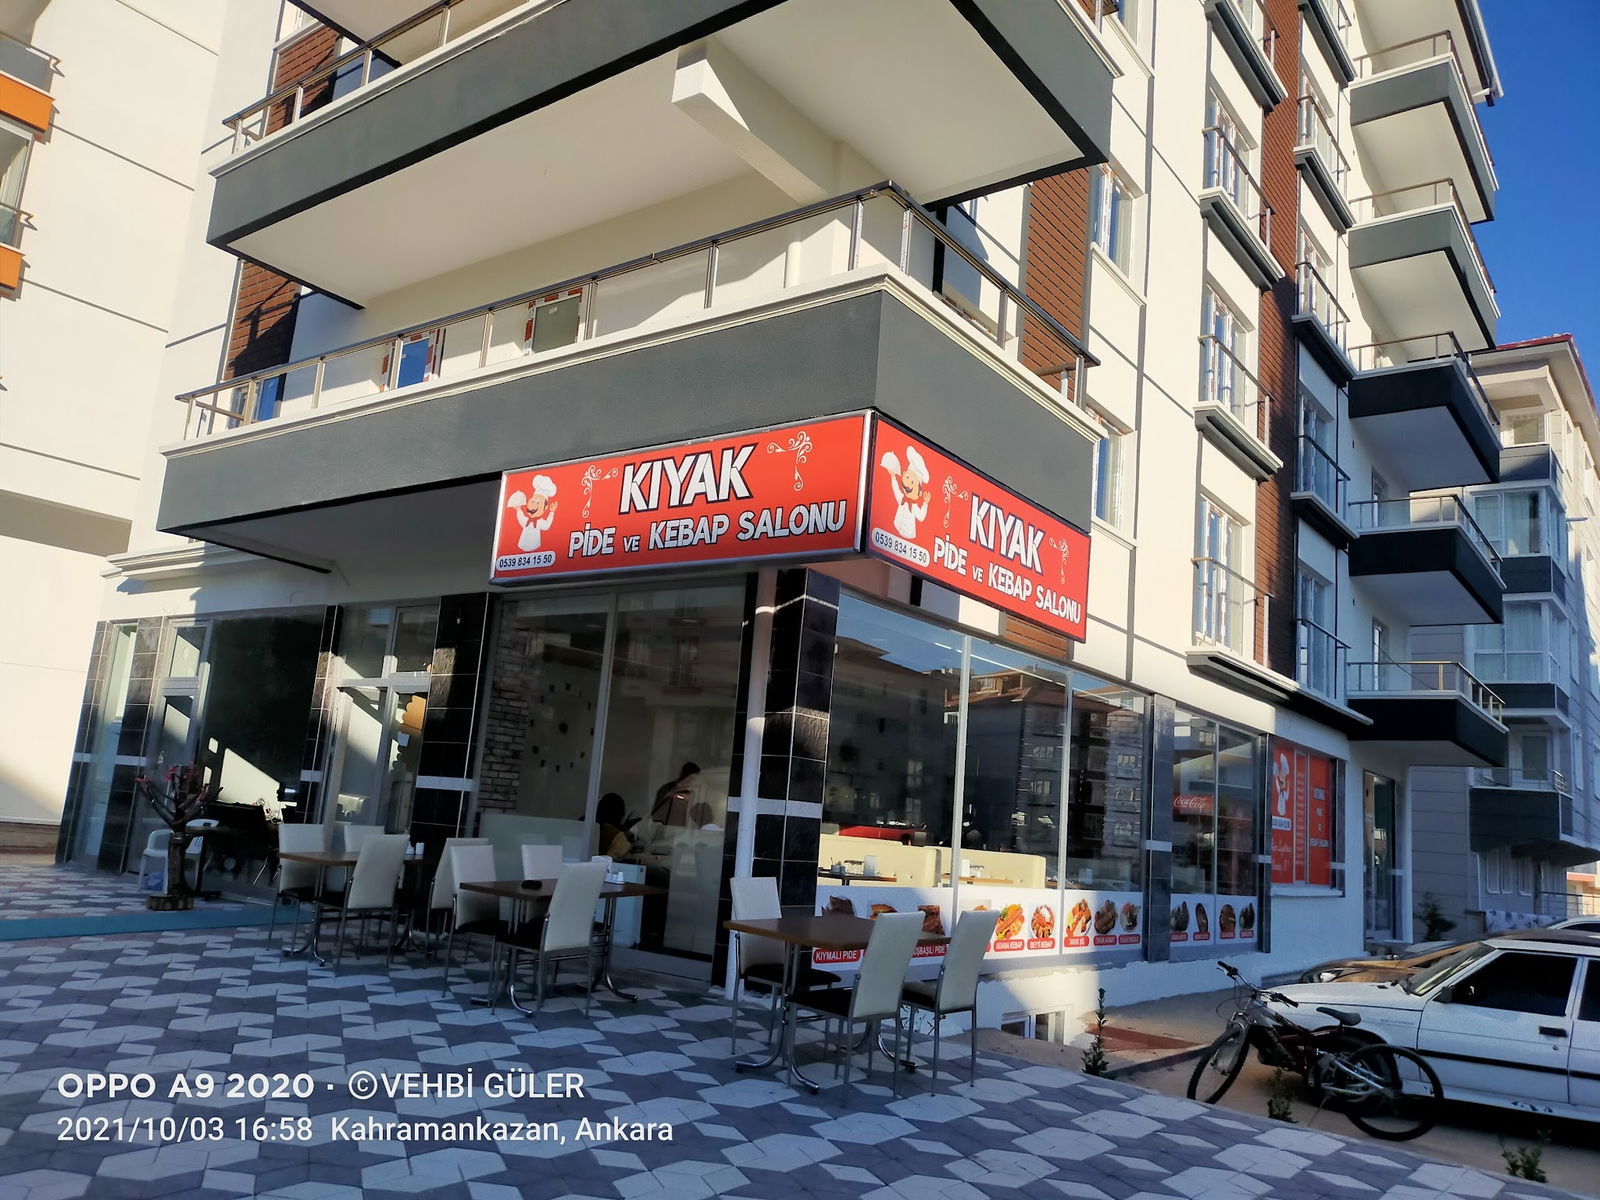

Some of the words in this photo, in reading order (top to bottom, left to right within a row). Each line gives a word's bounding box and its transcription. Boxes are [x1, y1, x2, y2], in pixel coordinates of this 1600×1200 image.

[619, 443, 758, 514] KIYAK
[568, 523, 617, 558] PİDE
[624, 535, 640, 552] VE
[649, 514, 729, 550] KEBAP
[736, 500, 847, 541] SALONU
[875, 531, 893, 548] 0539
[894, 540, 907, 554] 834
[910, 547, 917, 558] 15
[919, 551, 927, 563] 50
[969, 493, 1045, 575] KIYAK
[500, 558, 516, 568] 0539
[518, 556, 531, 566] 834
[533, 555, 542, 565] 15
[543, 553, 553, 563] 50
[934, 534, 968, 575] PİDE
[972, 565, 984, 583] VE
[988, 563, 1032, 601] KEBAP
[1035, 584, 1081, 624] SALONU
[815, 950, 841, 961] KIYMALI
